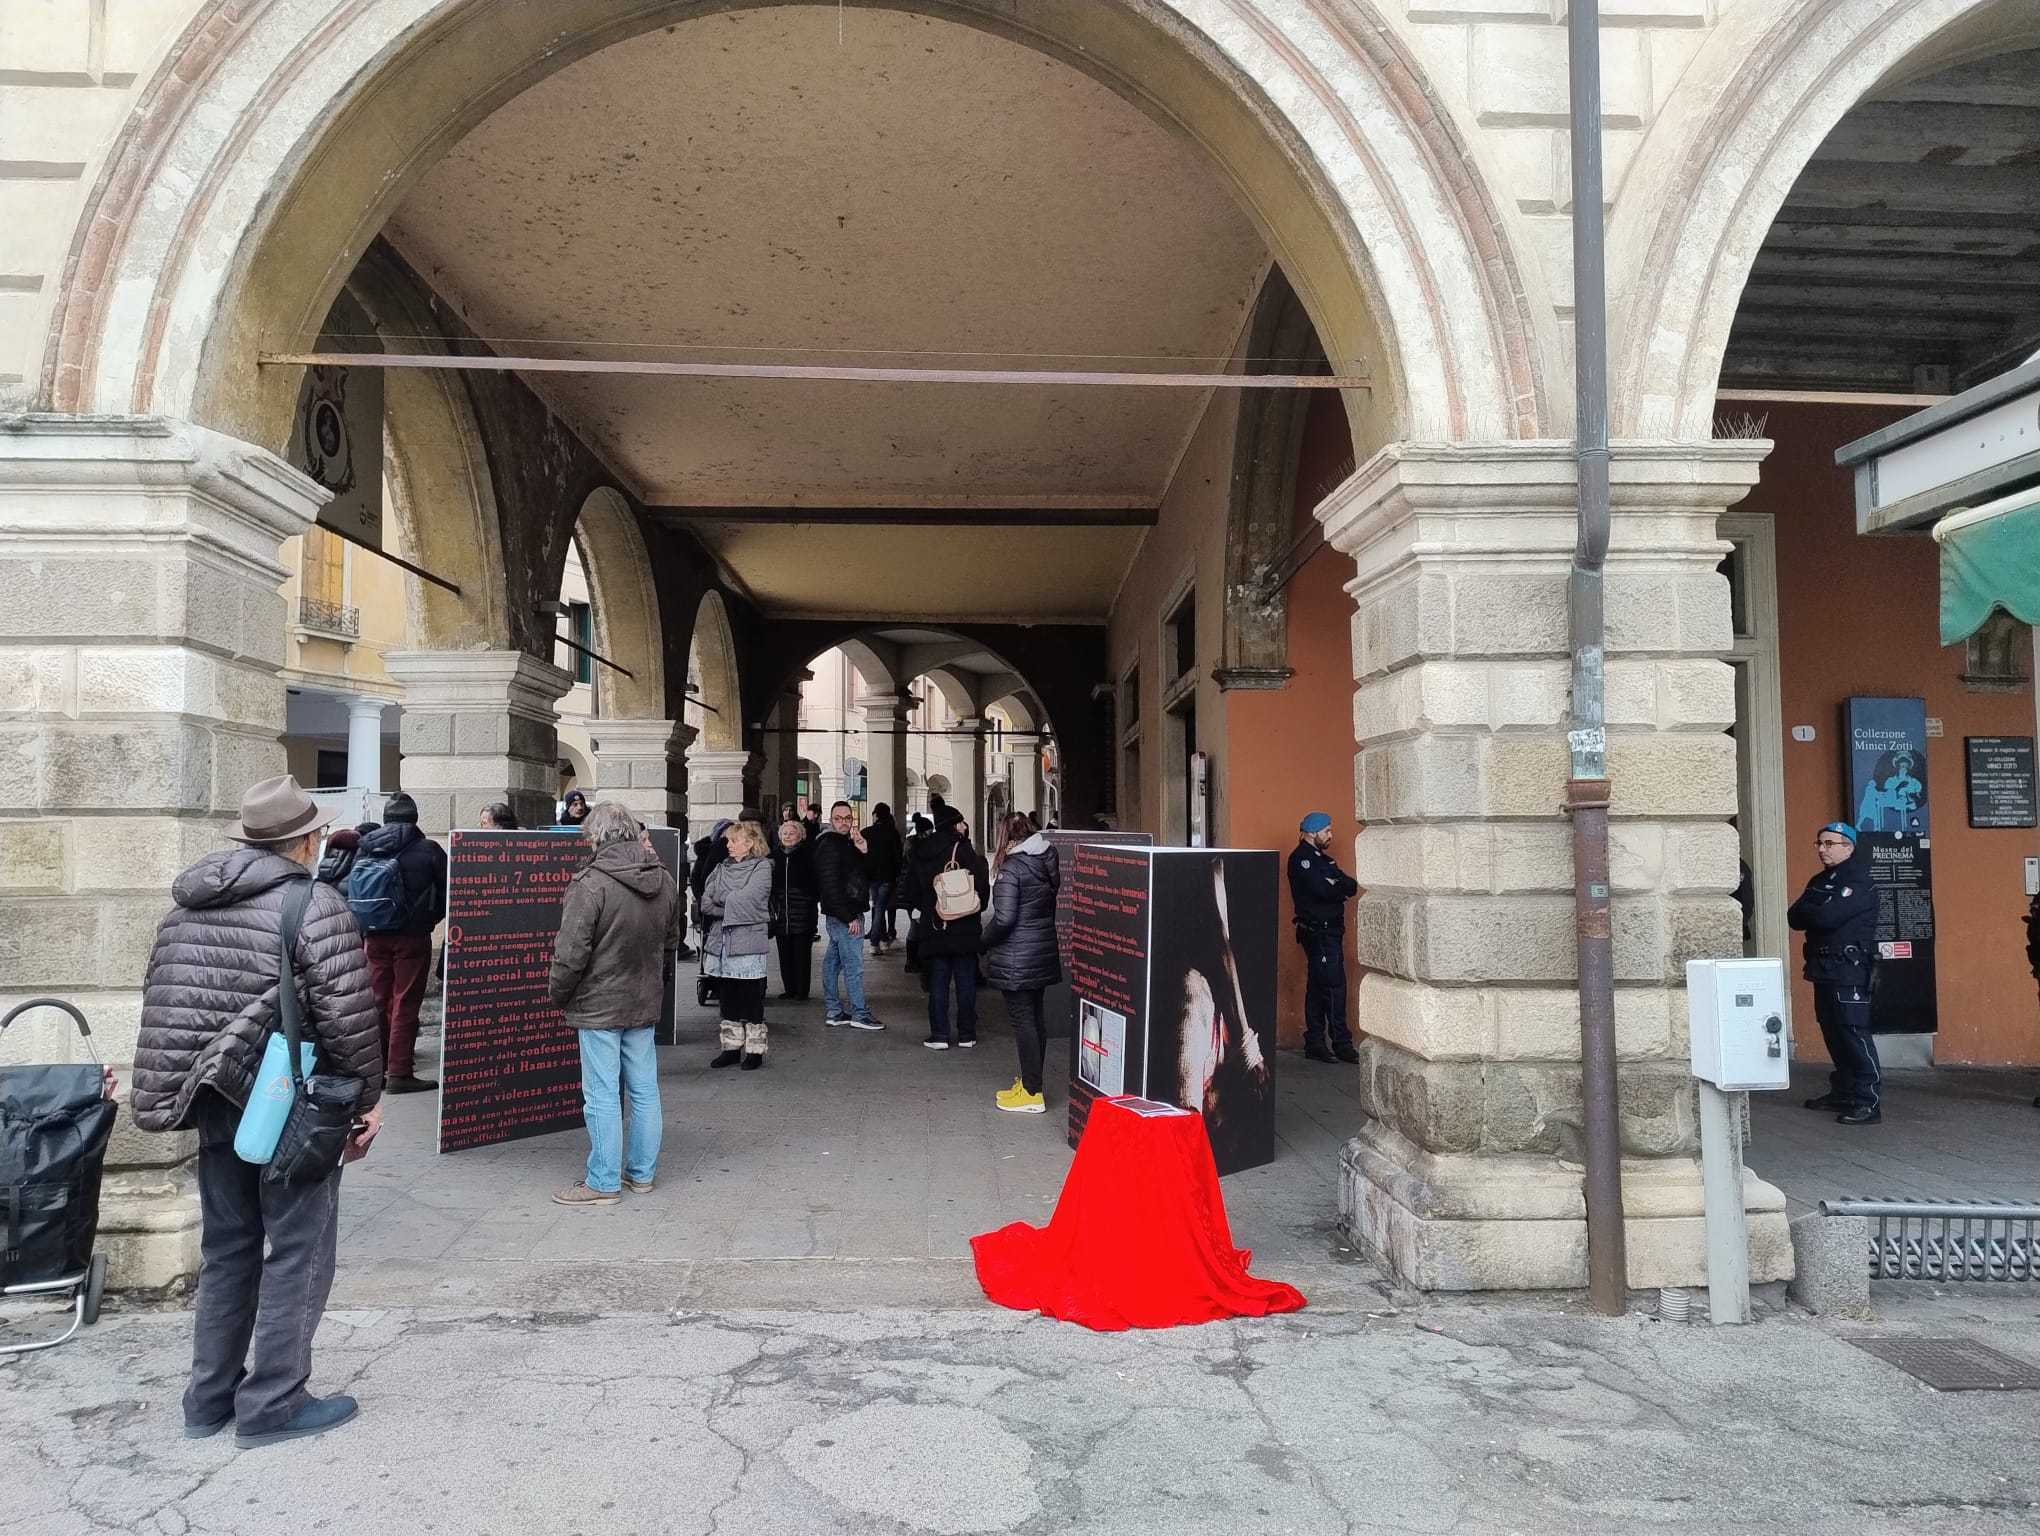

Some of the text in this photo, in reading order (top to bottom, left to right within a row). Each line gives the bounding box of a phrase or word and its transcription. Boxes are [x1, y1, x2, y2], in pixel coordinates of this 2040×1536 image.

[1854, 728, 1906, 738] Collezione
[1855, 740, 1913, 750] Minici Zotti
[516, 840, 548, 849] maggior
[551, 840, 572, 848] parte
[450, 852, 494, 863] vittime
[498, 852, 510, 862] di
[515, 852, 549, 864] stupri
[514, 871, 522, 884] 7
[482, 887, 509, 896] quindi
[464, 944, 498, 953] venendo
[464, 954, 519, 968] terroristi
[523, 953, 534, 964] di
[486, 969, 520, 981] social
[526, 968, 549, 978] med
[470, 1002, 493, 1012] prove
[496, 998, 526, 1008] trovate
[498, 1013, 521, 1023] dalle
[496, 1052, 517, 1061] dalle
[504, 1064, 515, 1074] di
[520, 1060, 558, 1073] Hamas
[455, 1100, 479, 1110] prove
[482, 1096, 492, 1104] di
[495, 1088, 542, 1102] violenza
